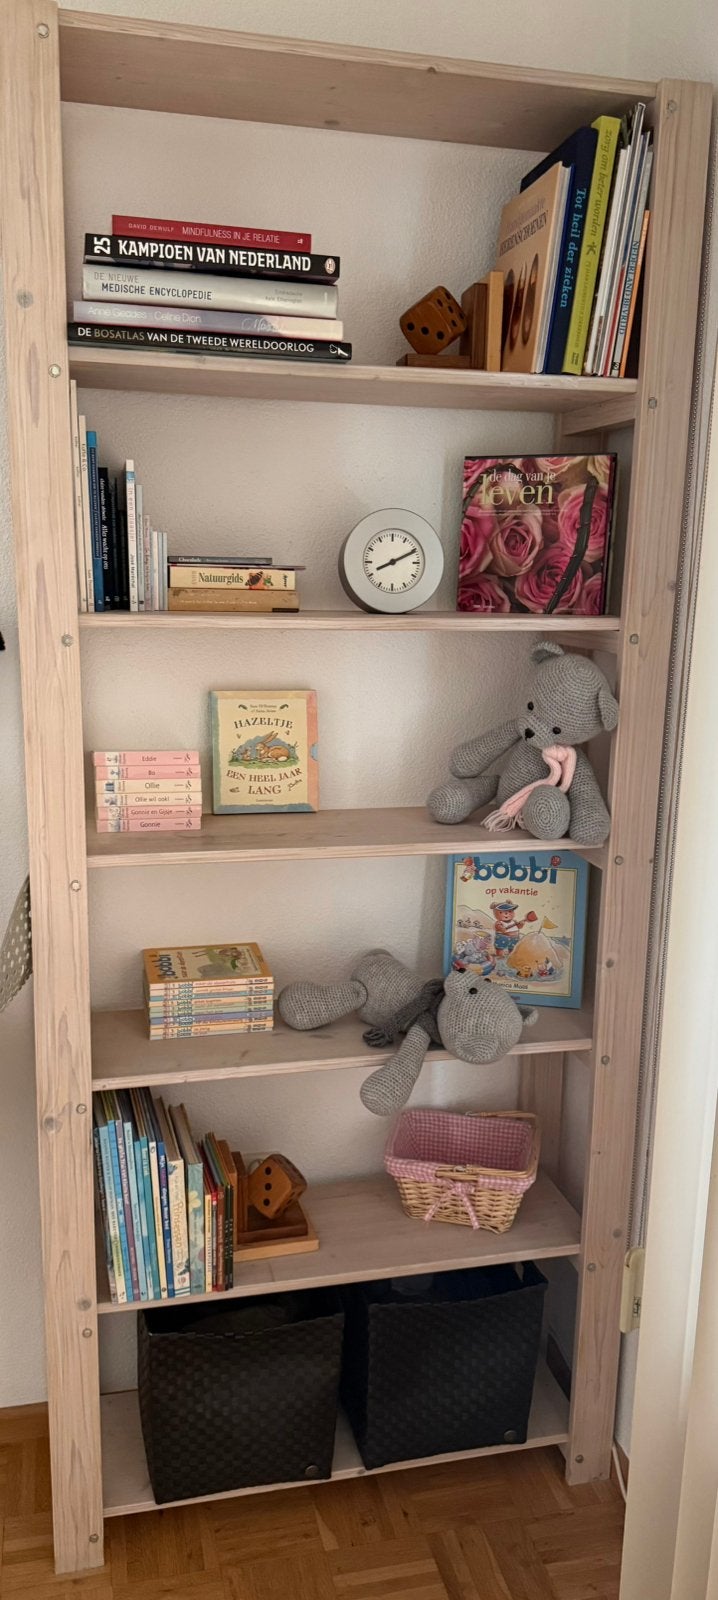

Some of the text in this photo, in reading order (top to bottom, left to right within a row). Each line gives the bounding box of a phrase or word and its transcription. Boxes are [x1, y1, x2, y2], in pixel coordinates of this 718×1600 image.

[589, 129, 613, 236] zorg om beter worden
[182, 226, 280, 244] MINDFULNESS IN JE RELATIE
[94, 236, 111, 254] 25
[558, 187, 587, 308] Tot heil der zieken
[118, 240, 311, 271] KAMPIOEN VAN NEDERLAND
[622, 240, 640, 296] NEDERLAND
[94, 272, 139, 283] DE NIEUWE
[102, 283, 212, 300] MEDISCHE ENCYCLOPEDIE
[88, 306, 110, 316] Anne
[77, 327, 314, 353] DE BOSATLAS VAN DE TWEEDE WERELDOORLOG
[489, 470, 556, 484] de dag van je
[480, 473, 553, 505] leven
[198, 572, 243, 585] Natuurgids
[234, 717, 293, 729] HAZELTJE
[226, 767, 302, 782] EEN HEEL JAAR
[248, 785, 281, 795] LANG
[474, 855, 560, 884] bobbi
[485, 886, 539, 898] op vakantie
